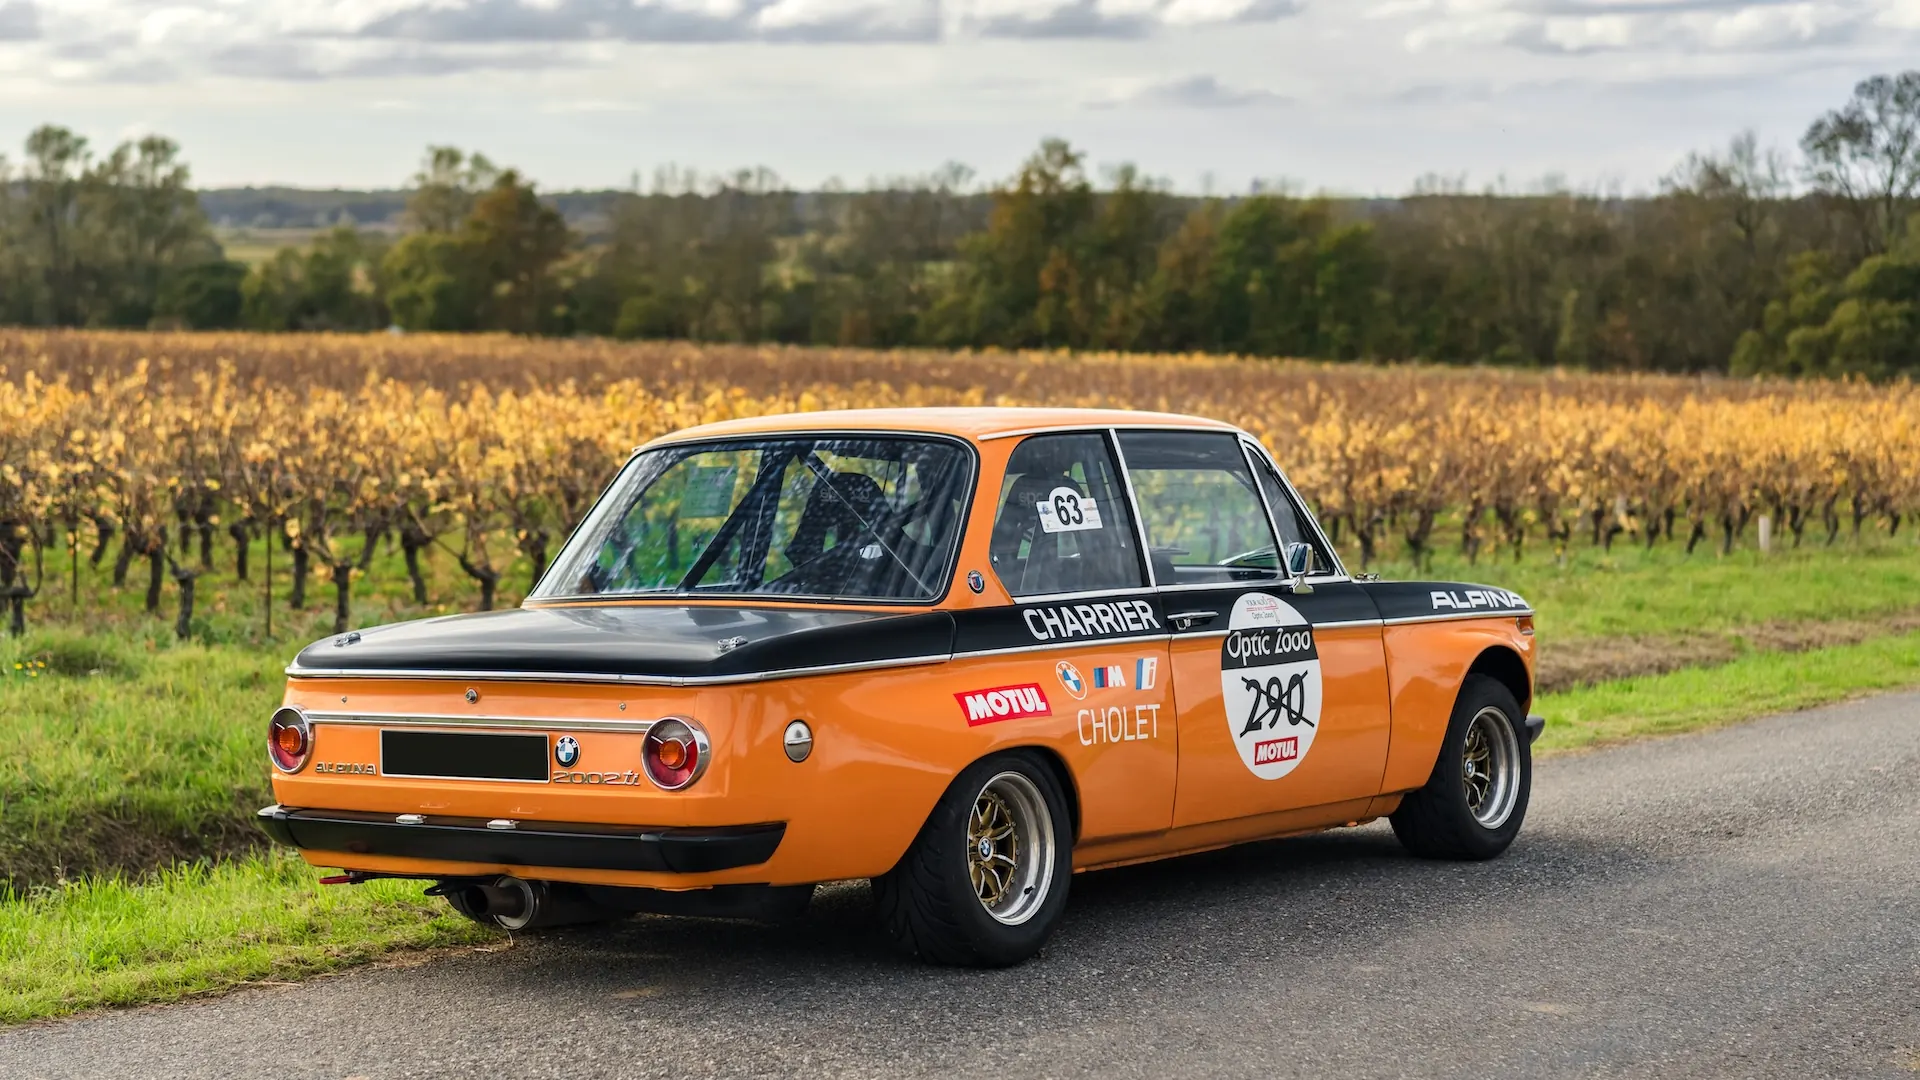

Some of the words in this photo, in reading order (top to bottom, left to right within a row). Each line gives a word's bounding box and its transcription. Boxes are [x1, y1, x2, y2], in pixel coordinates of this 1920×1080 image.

[1054, 494, 1084, 526] 63
[1430, 590, 1530, 610] ALPINA
[1022, 600, 1161, 641] CHARRIER
[1227, 630, 1271, 666] Optic
[1275, 628, 1311, 654] 2000
[964, 687, 1047, 721] MOTUL
[1244, 672, 1306, 732] 290
[1077, 704, 1160, 746] CHOLET
[1256, 740, 1296, 763] MOTUL
